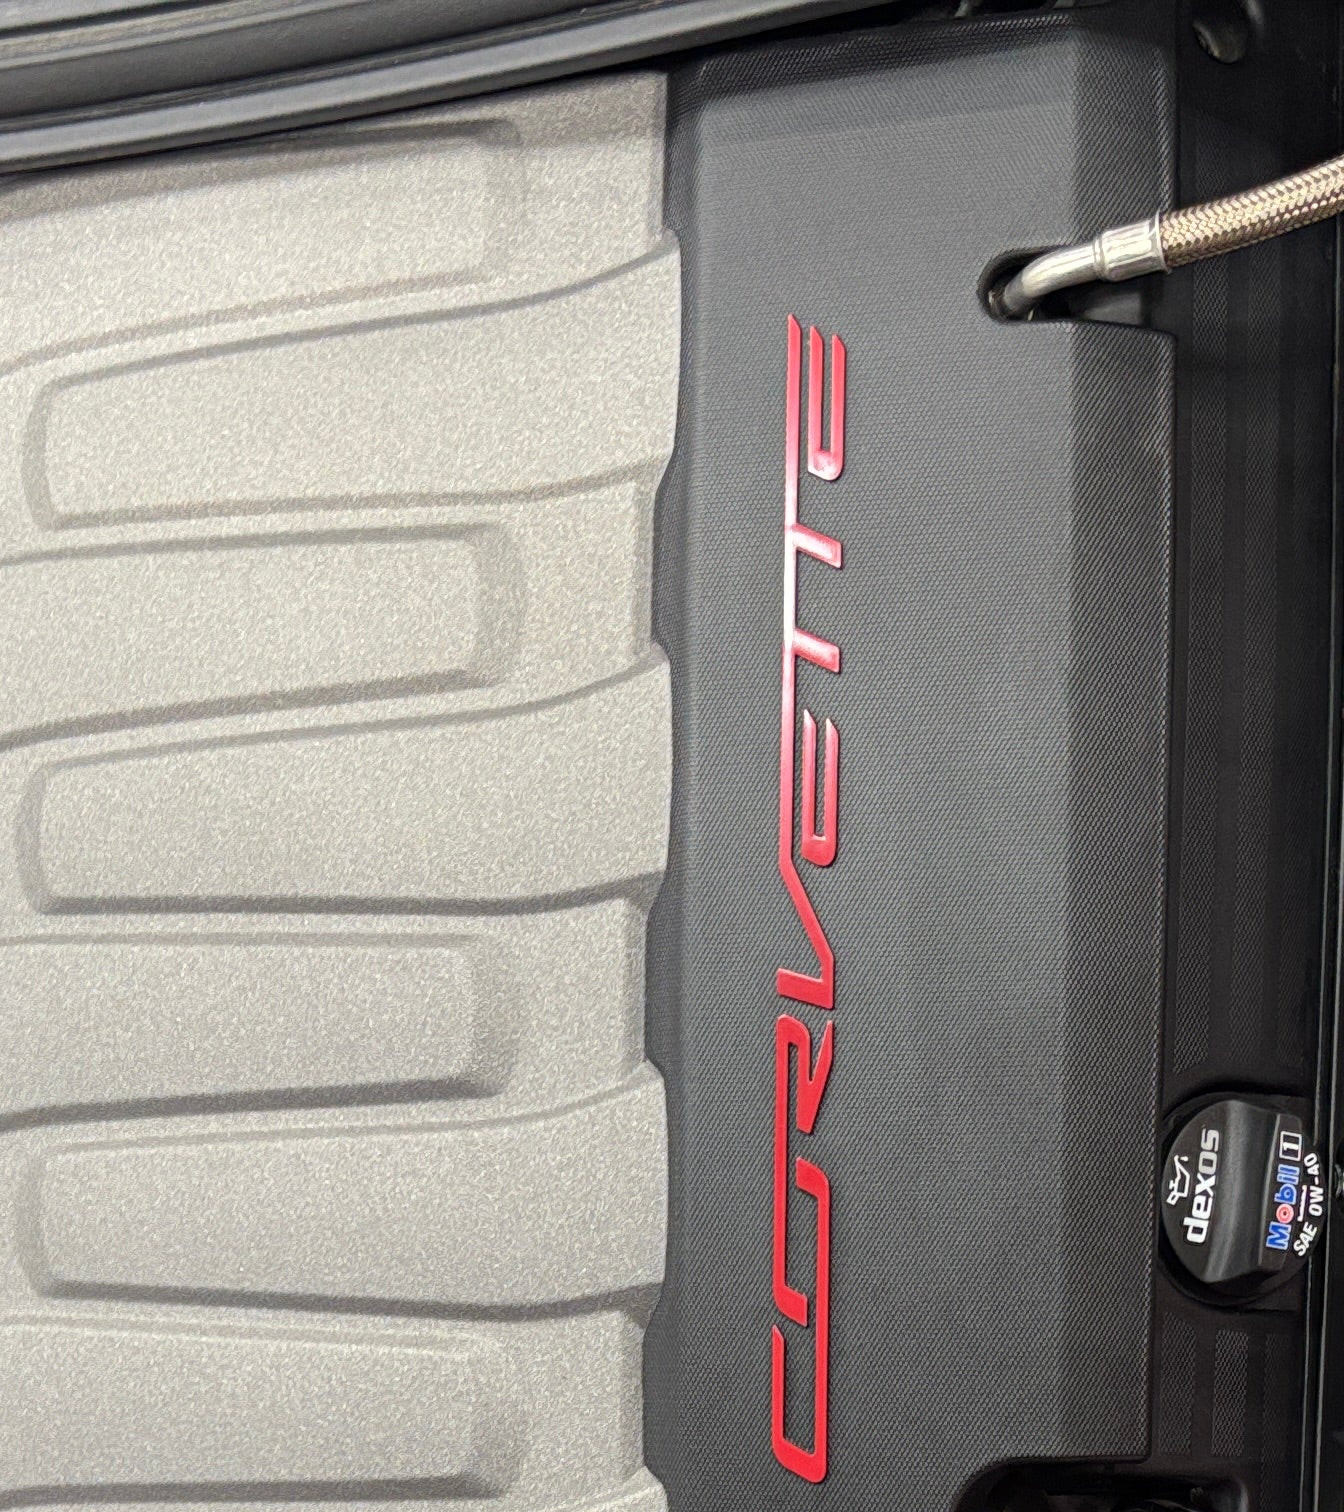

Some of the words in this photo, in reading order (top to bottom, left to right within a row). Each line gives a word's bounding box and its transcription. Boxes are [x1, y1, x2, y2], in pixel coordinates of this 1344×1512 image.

[770, 313, 846, 1483] CORVETTE
[1183, 1129, 1220, 1244] dexos
[1266, 1164, 1301, 1250] Mobil
[1304, 1153, 1325, 1217] 0W-40
[1293, 1222, 1318, 1257] SAE
